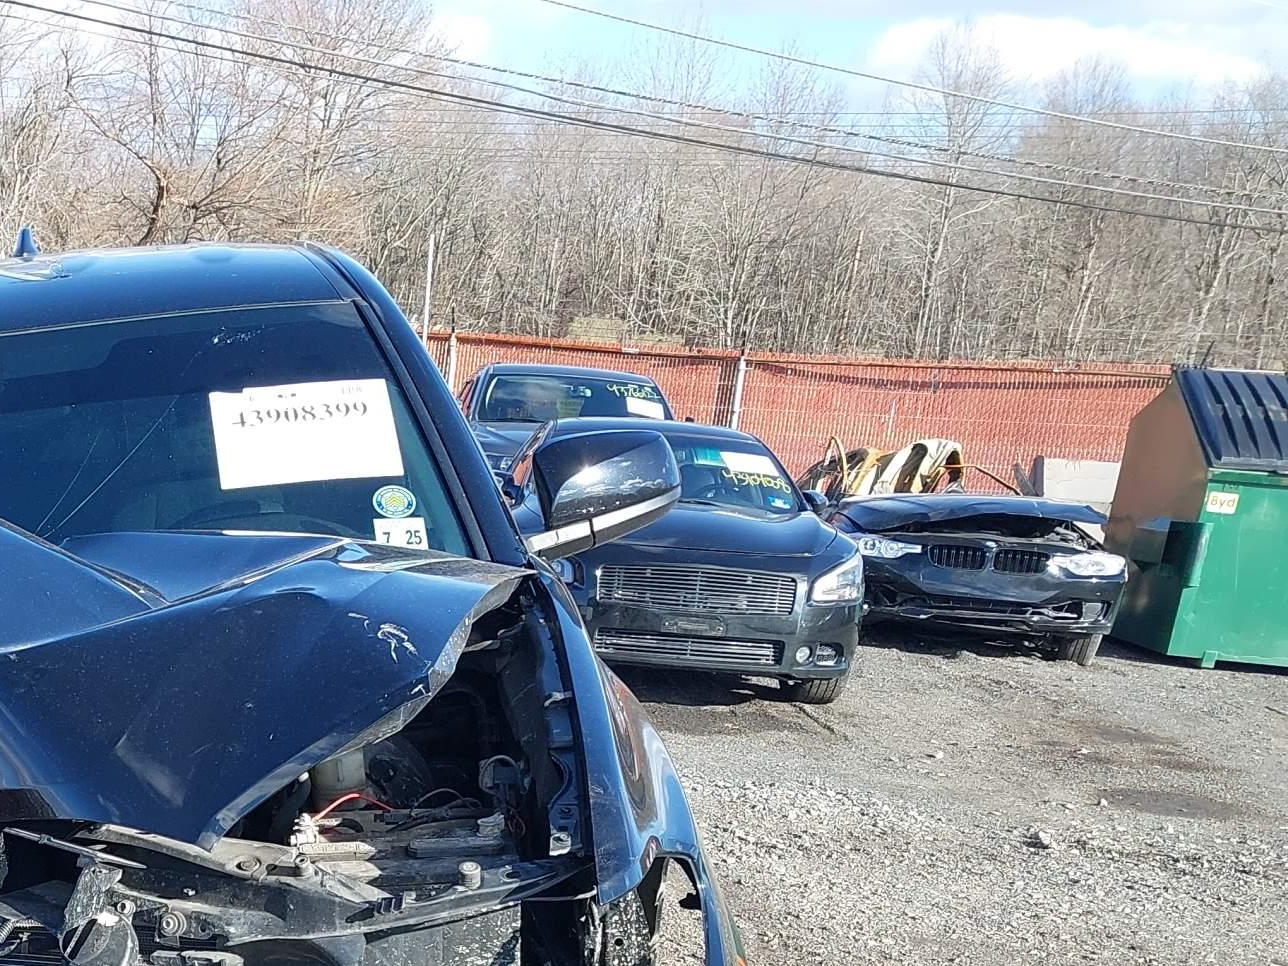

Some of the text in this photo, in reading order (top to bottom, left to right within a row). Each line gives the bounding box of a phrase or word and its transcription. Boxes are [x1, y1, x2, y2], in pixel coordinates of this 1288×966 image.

[231, 401, 368, 429] 43908399
[382, 529, 423, 545] 7 25
